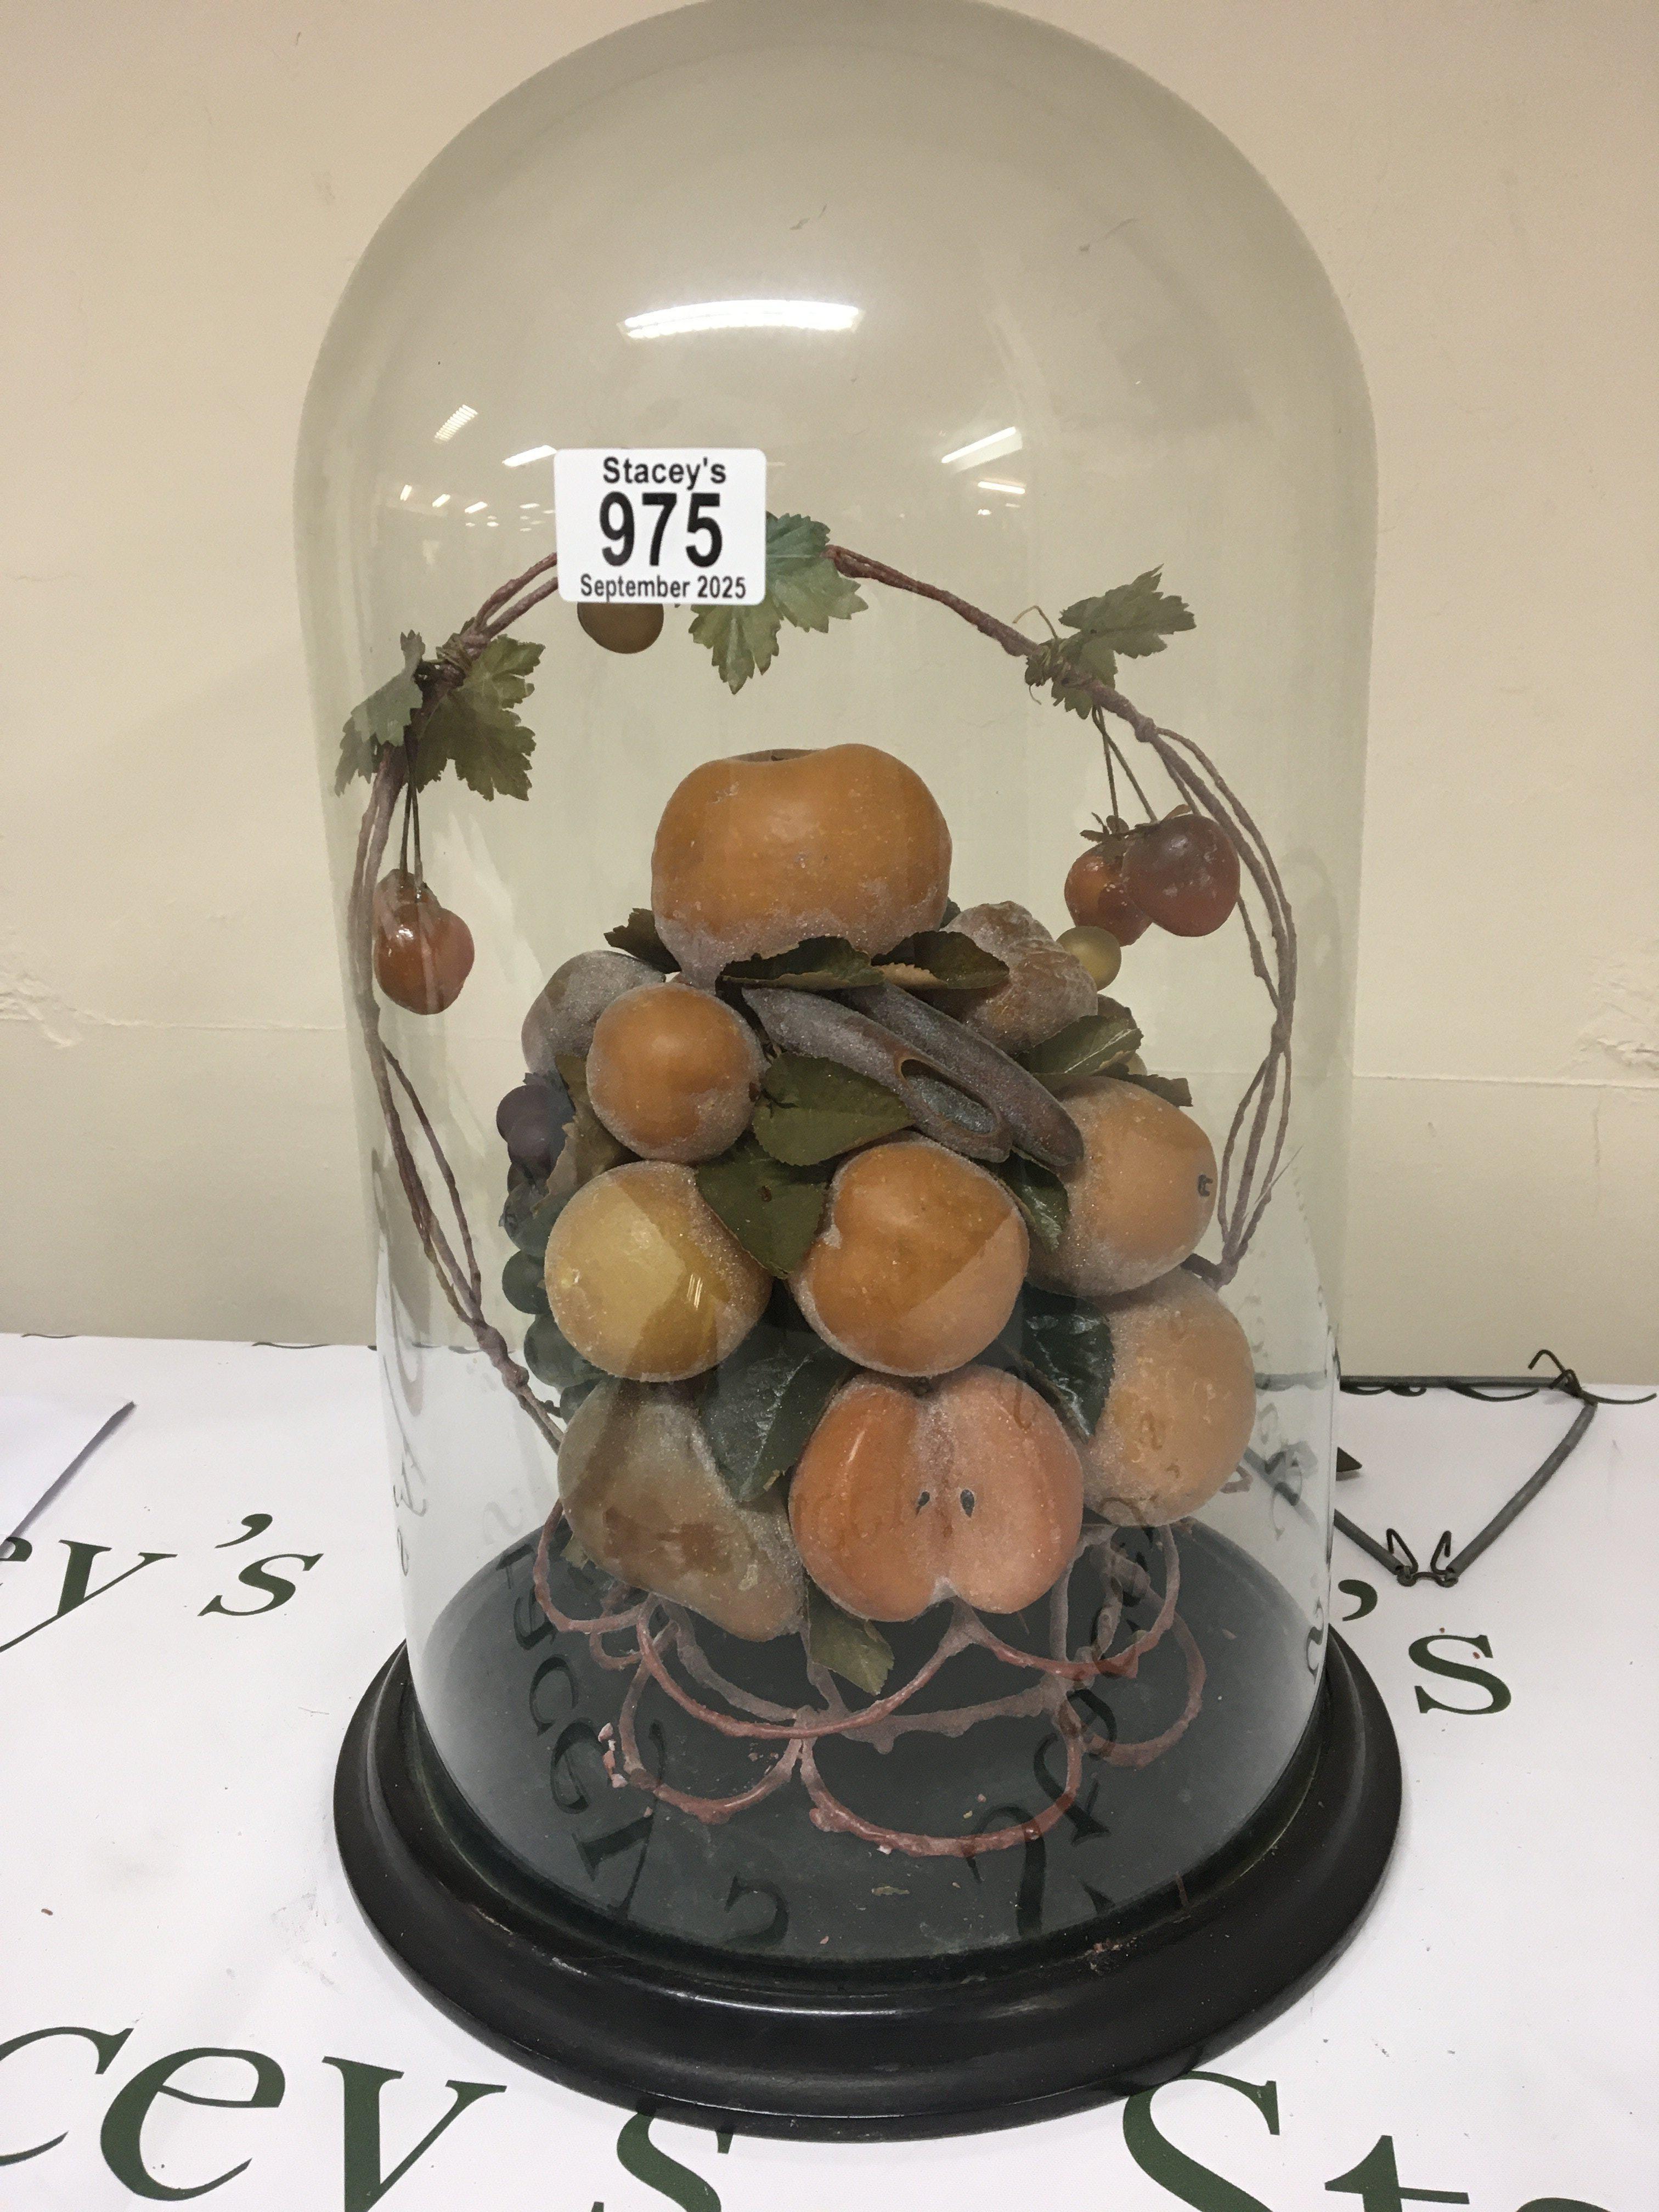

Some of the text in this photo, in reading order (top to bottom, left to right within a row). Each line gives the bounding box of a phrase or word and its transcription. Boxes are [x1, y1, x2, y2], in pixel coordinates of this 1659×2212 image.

[603, 456, 726, 490] Stacey's
[599, 491, 723, 567] 975
[580, 573, 746, 601] September 2025
